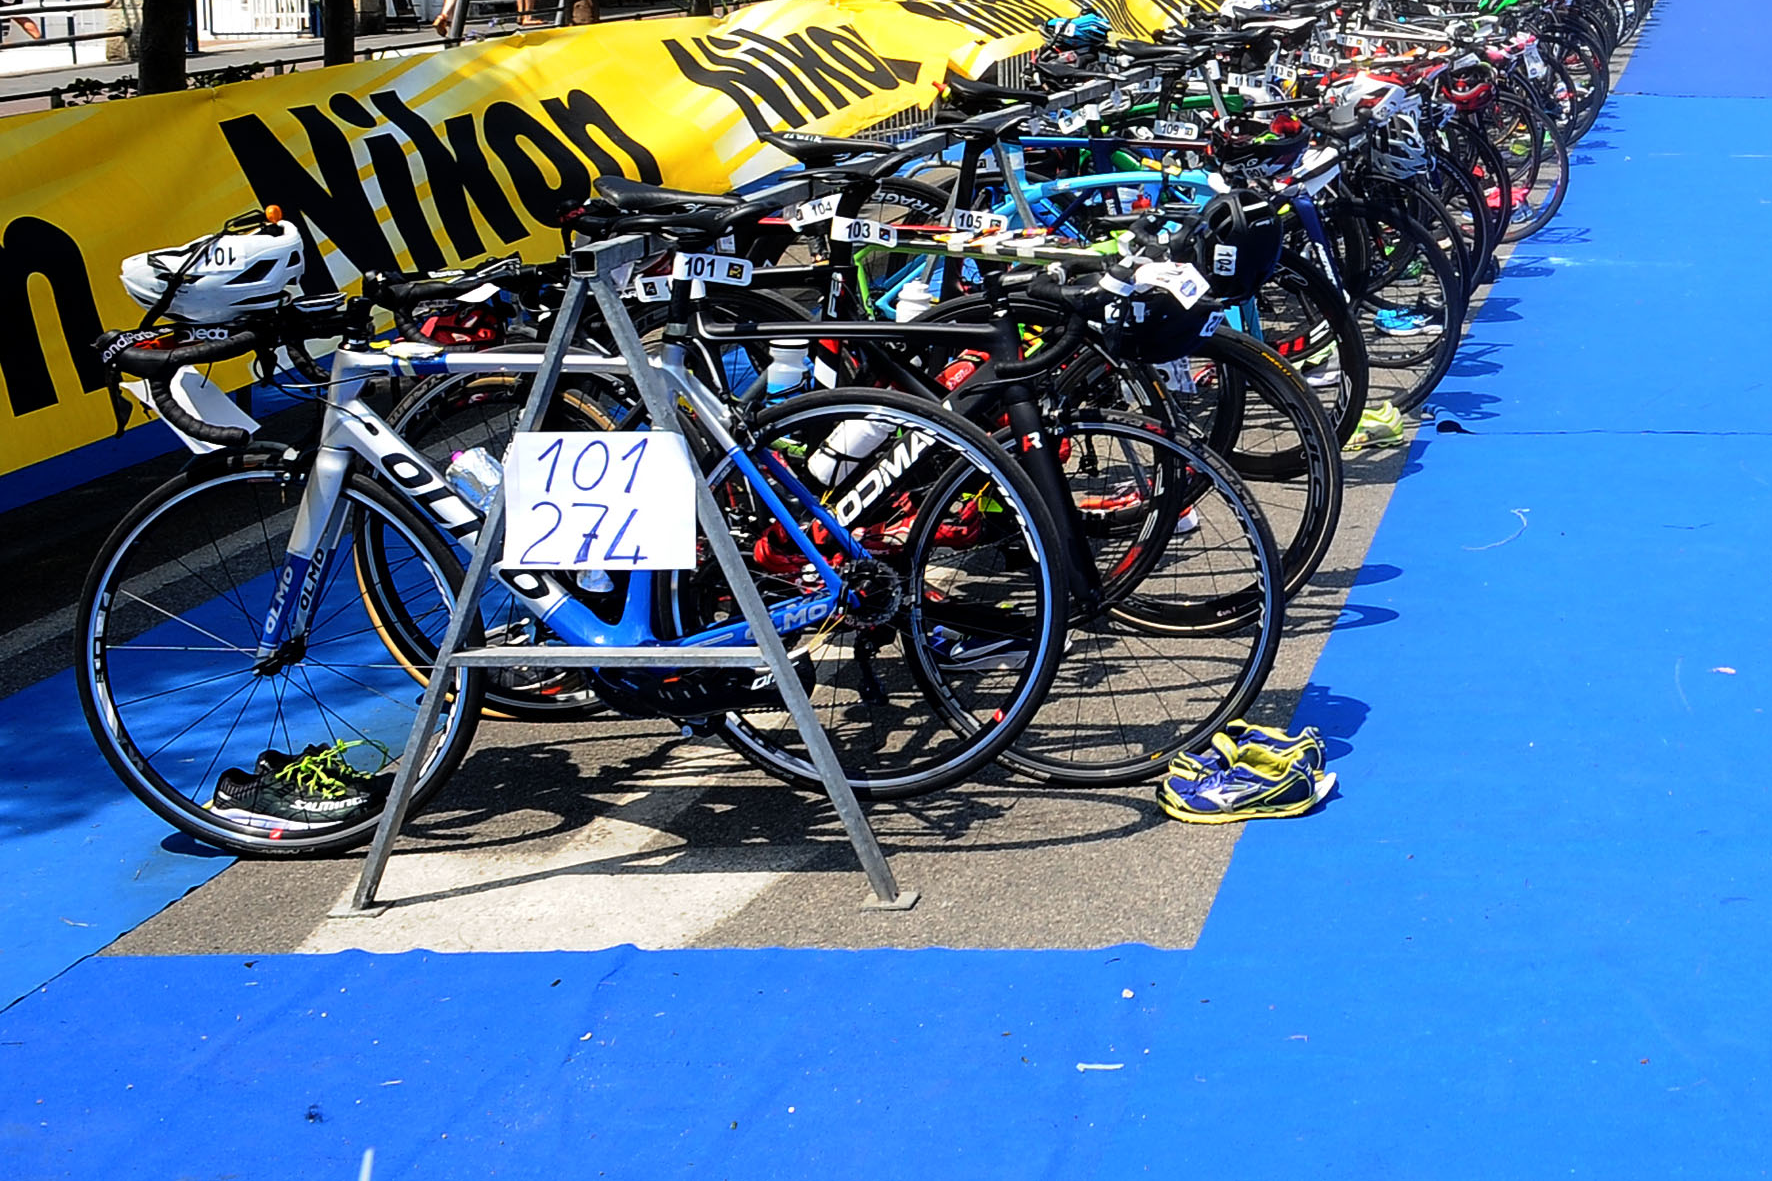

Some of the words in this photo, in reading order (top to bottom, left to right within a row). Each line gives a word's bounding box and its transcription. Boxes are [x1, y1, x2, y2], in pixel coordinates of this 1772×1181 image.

[662, 24, 900, 142] Niko
[219, 87, 664, 297] Nikon
[810, 200, 834, 217] 104
[845, 222, 872, 240] 103
[957, 213, 983, 229] 105
[684, 256, 717, 279] 101
[1217, 251, 1234, 273] 104
[537, 437, 649, 494] 101
[381, 451, 549, 600] OLO
[519, 501, 648, 565] 274
[264, 564, 295, 636] OLMO
[299, 546, 326, 612] OLMO
[744, 602, 828, 642] OMO
